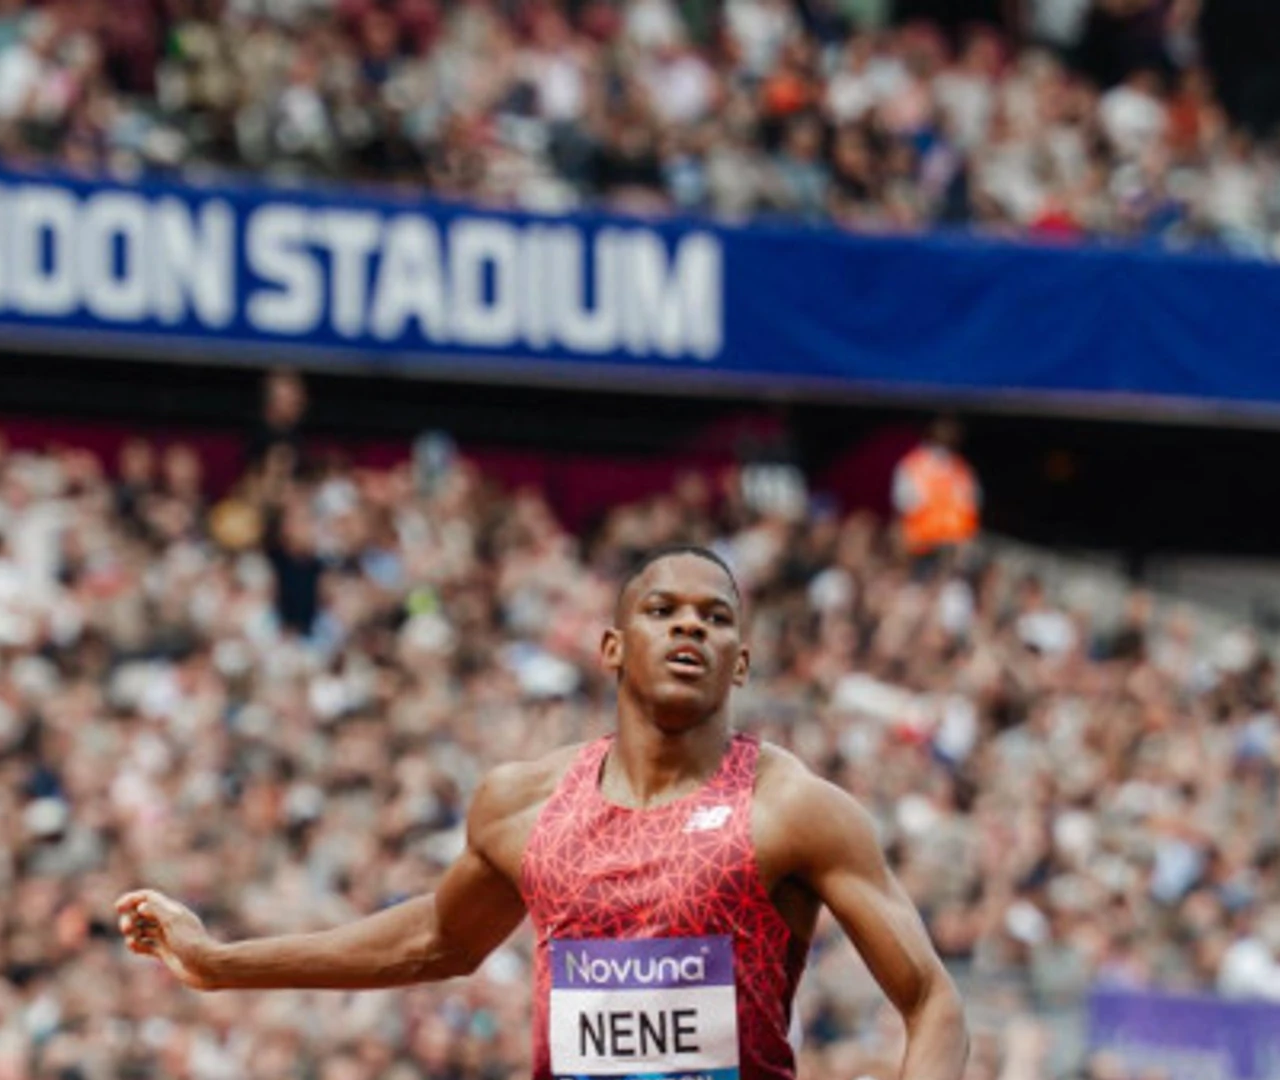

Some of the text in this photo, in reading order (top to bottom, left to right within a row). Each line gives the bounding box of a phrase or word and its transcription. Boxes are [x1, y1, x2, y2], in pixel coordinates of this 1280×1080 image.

[244, 199, 723, 361] STADIUM
[566, 949, 705, 984] Novuna
[579, 1009, 700, 1058] NENE
